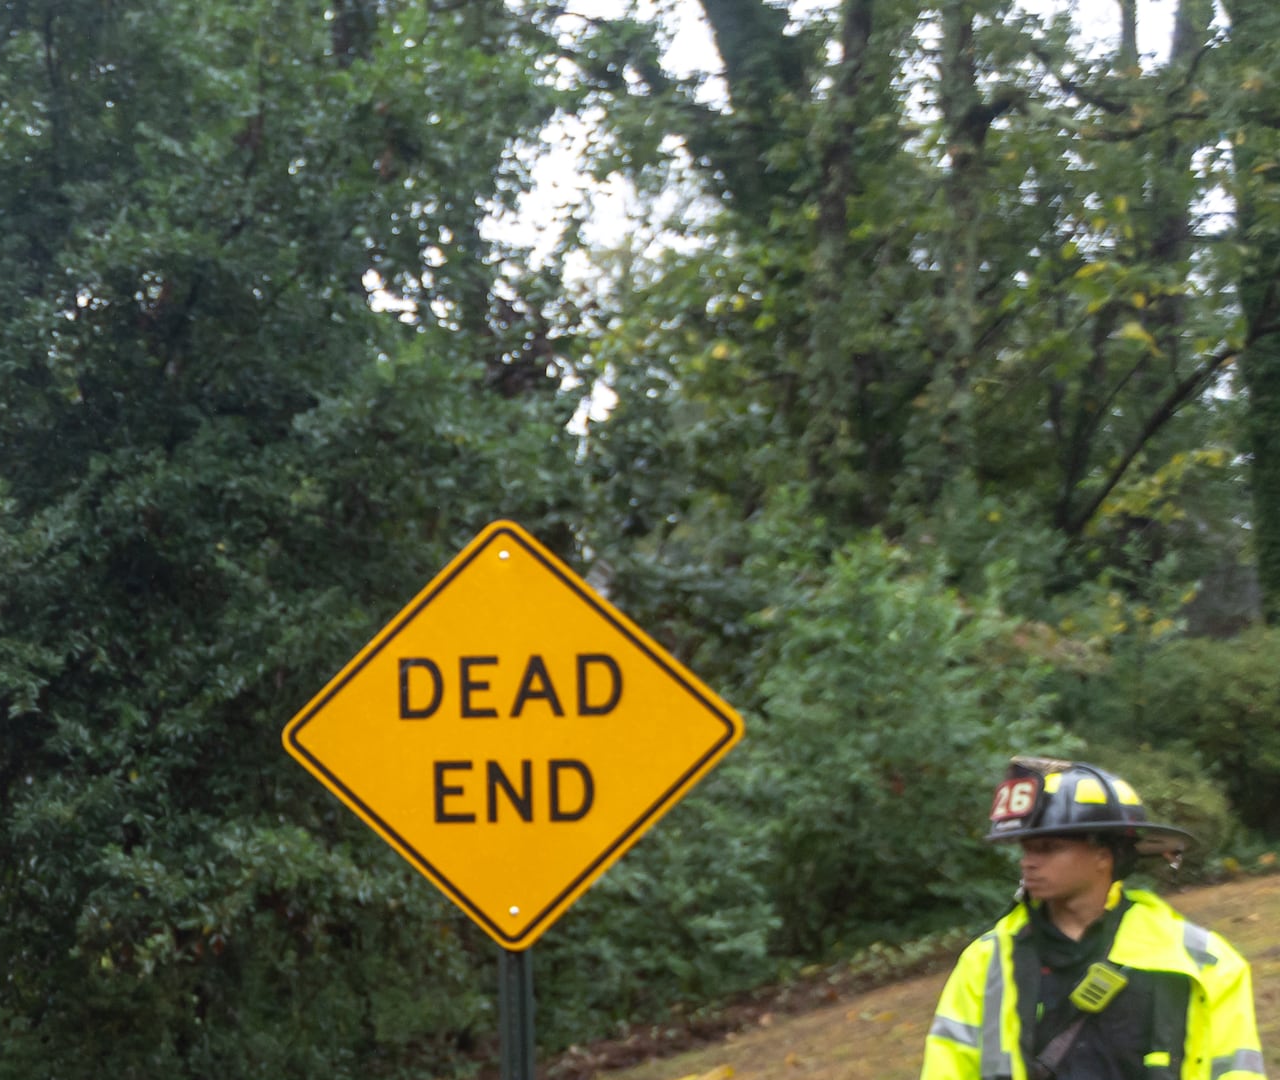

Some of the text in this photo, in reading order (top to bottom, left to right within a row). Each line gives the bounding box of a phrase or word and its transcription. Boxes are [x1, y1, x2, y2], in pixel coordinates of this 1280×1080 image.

[397, 653, 624, 720] DEAD
[433, 758, 596, 824] END
[993, 781, 1033, 815] 26
